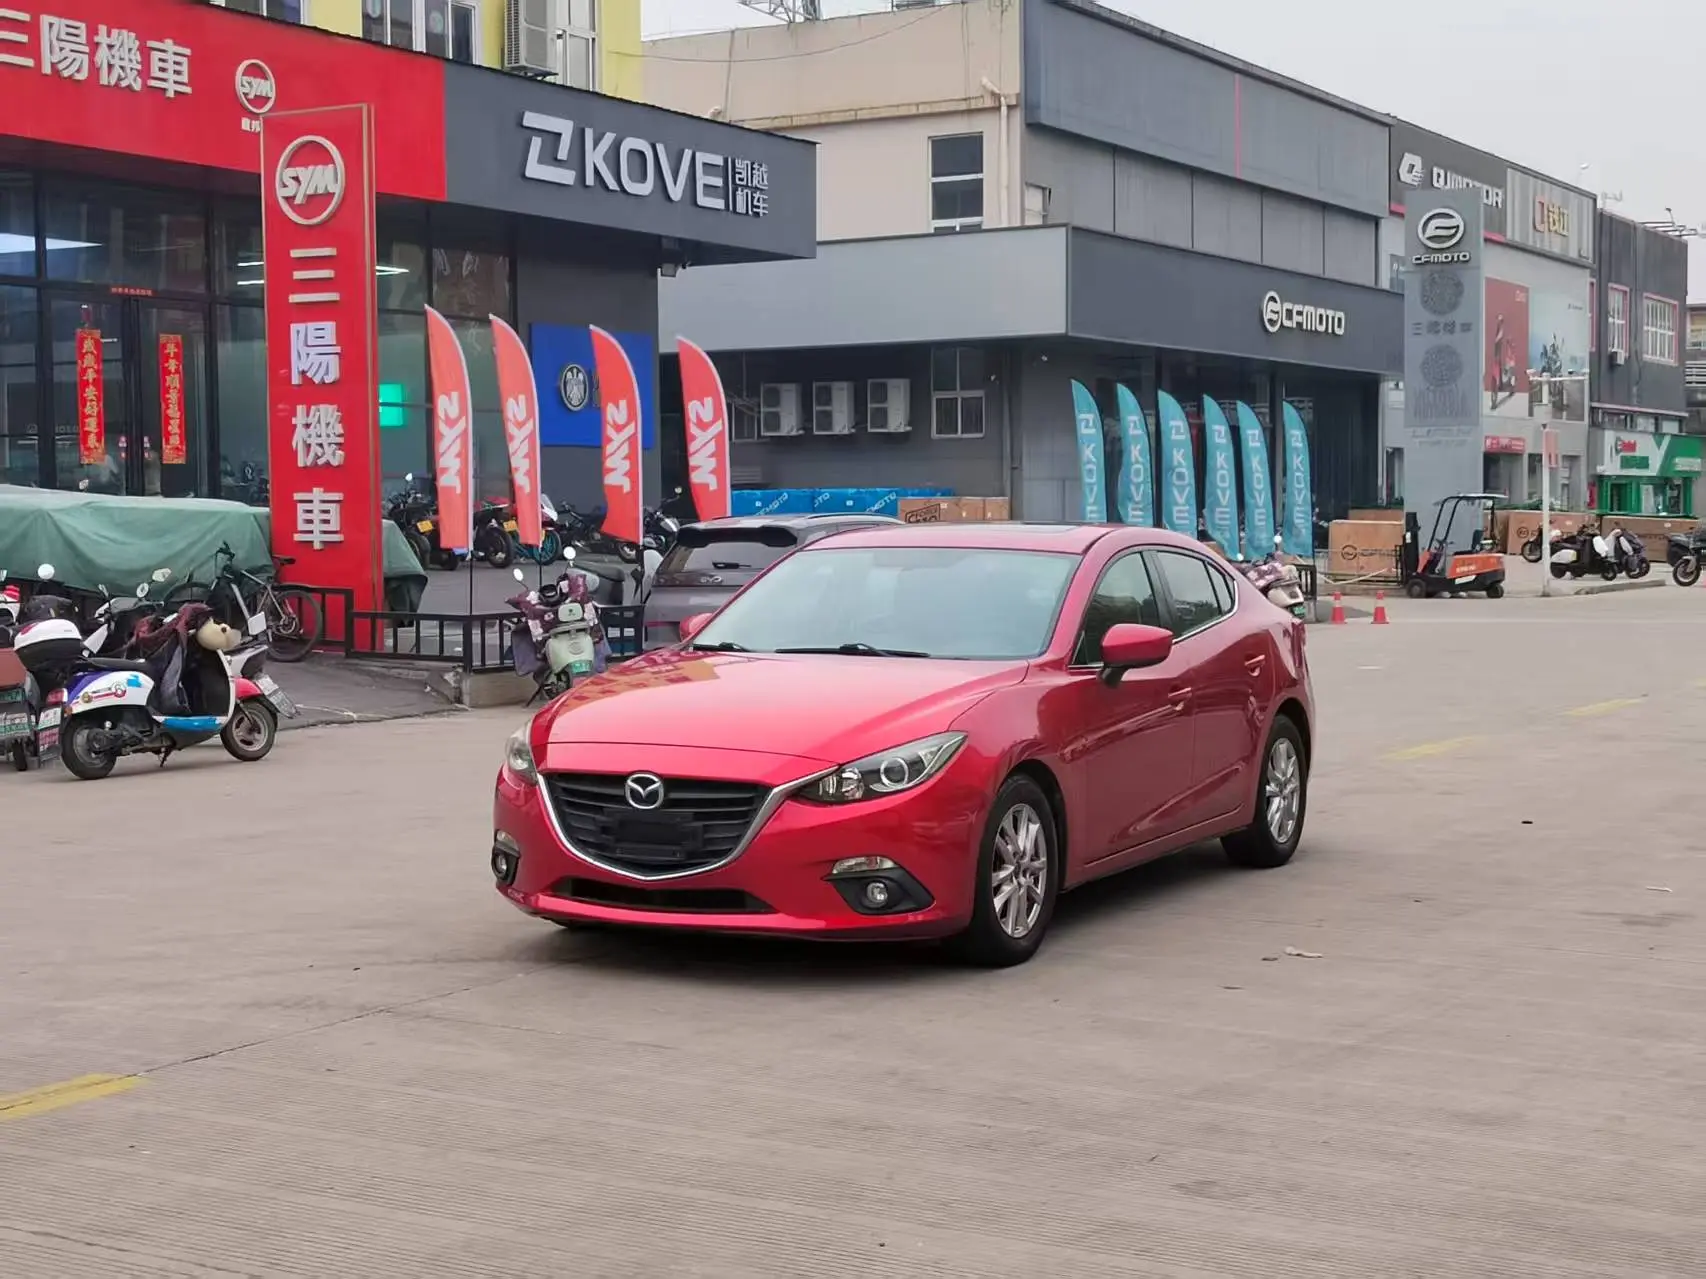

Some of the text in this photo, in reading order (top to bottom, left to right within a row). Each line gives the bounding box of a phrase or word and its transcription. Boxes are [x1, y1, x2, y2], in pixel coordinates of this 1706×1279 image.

[0, 8, 193, 98] 三陽機車
[240, 76, 272, 99] SYM
[280, 164, 337, 205] SYM
[584, 127, 725, 210] KOVE
[735, 158, 769, 189] 凯越
[735, 187, 769, 217] 机车
[1412, 251, 1470, 263] CFMOTO
[1282, 302, 1345, 335] CFMOTO
[289, 248, 345, 550] 三陽機車
[1080, 444, 1099, 521] KOVE
[1128, 444, 1144, 521] KOVE
[1172, 449, 1189, 524] KOVE
[1215, 452, 1231, 525] KOVE
[1252, 456, 1266, 525] KOVE
[1293, 454, 1305, 525] KOVE
